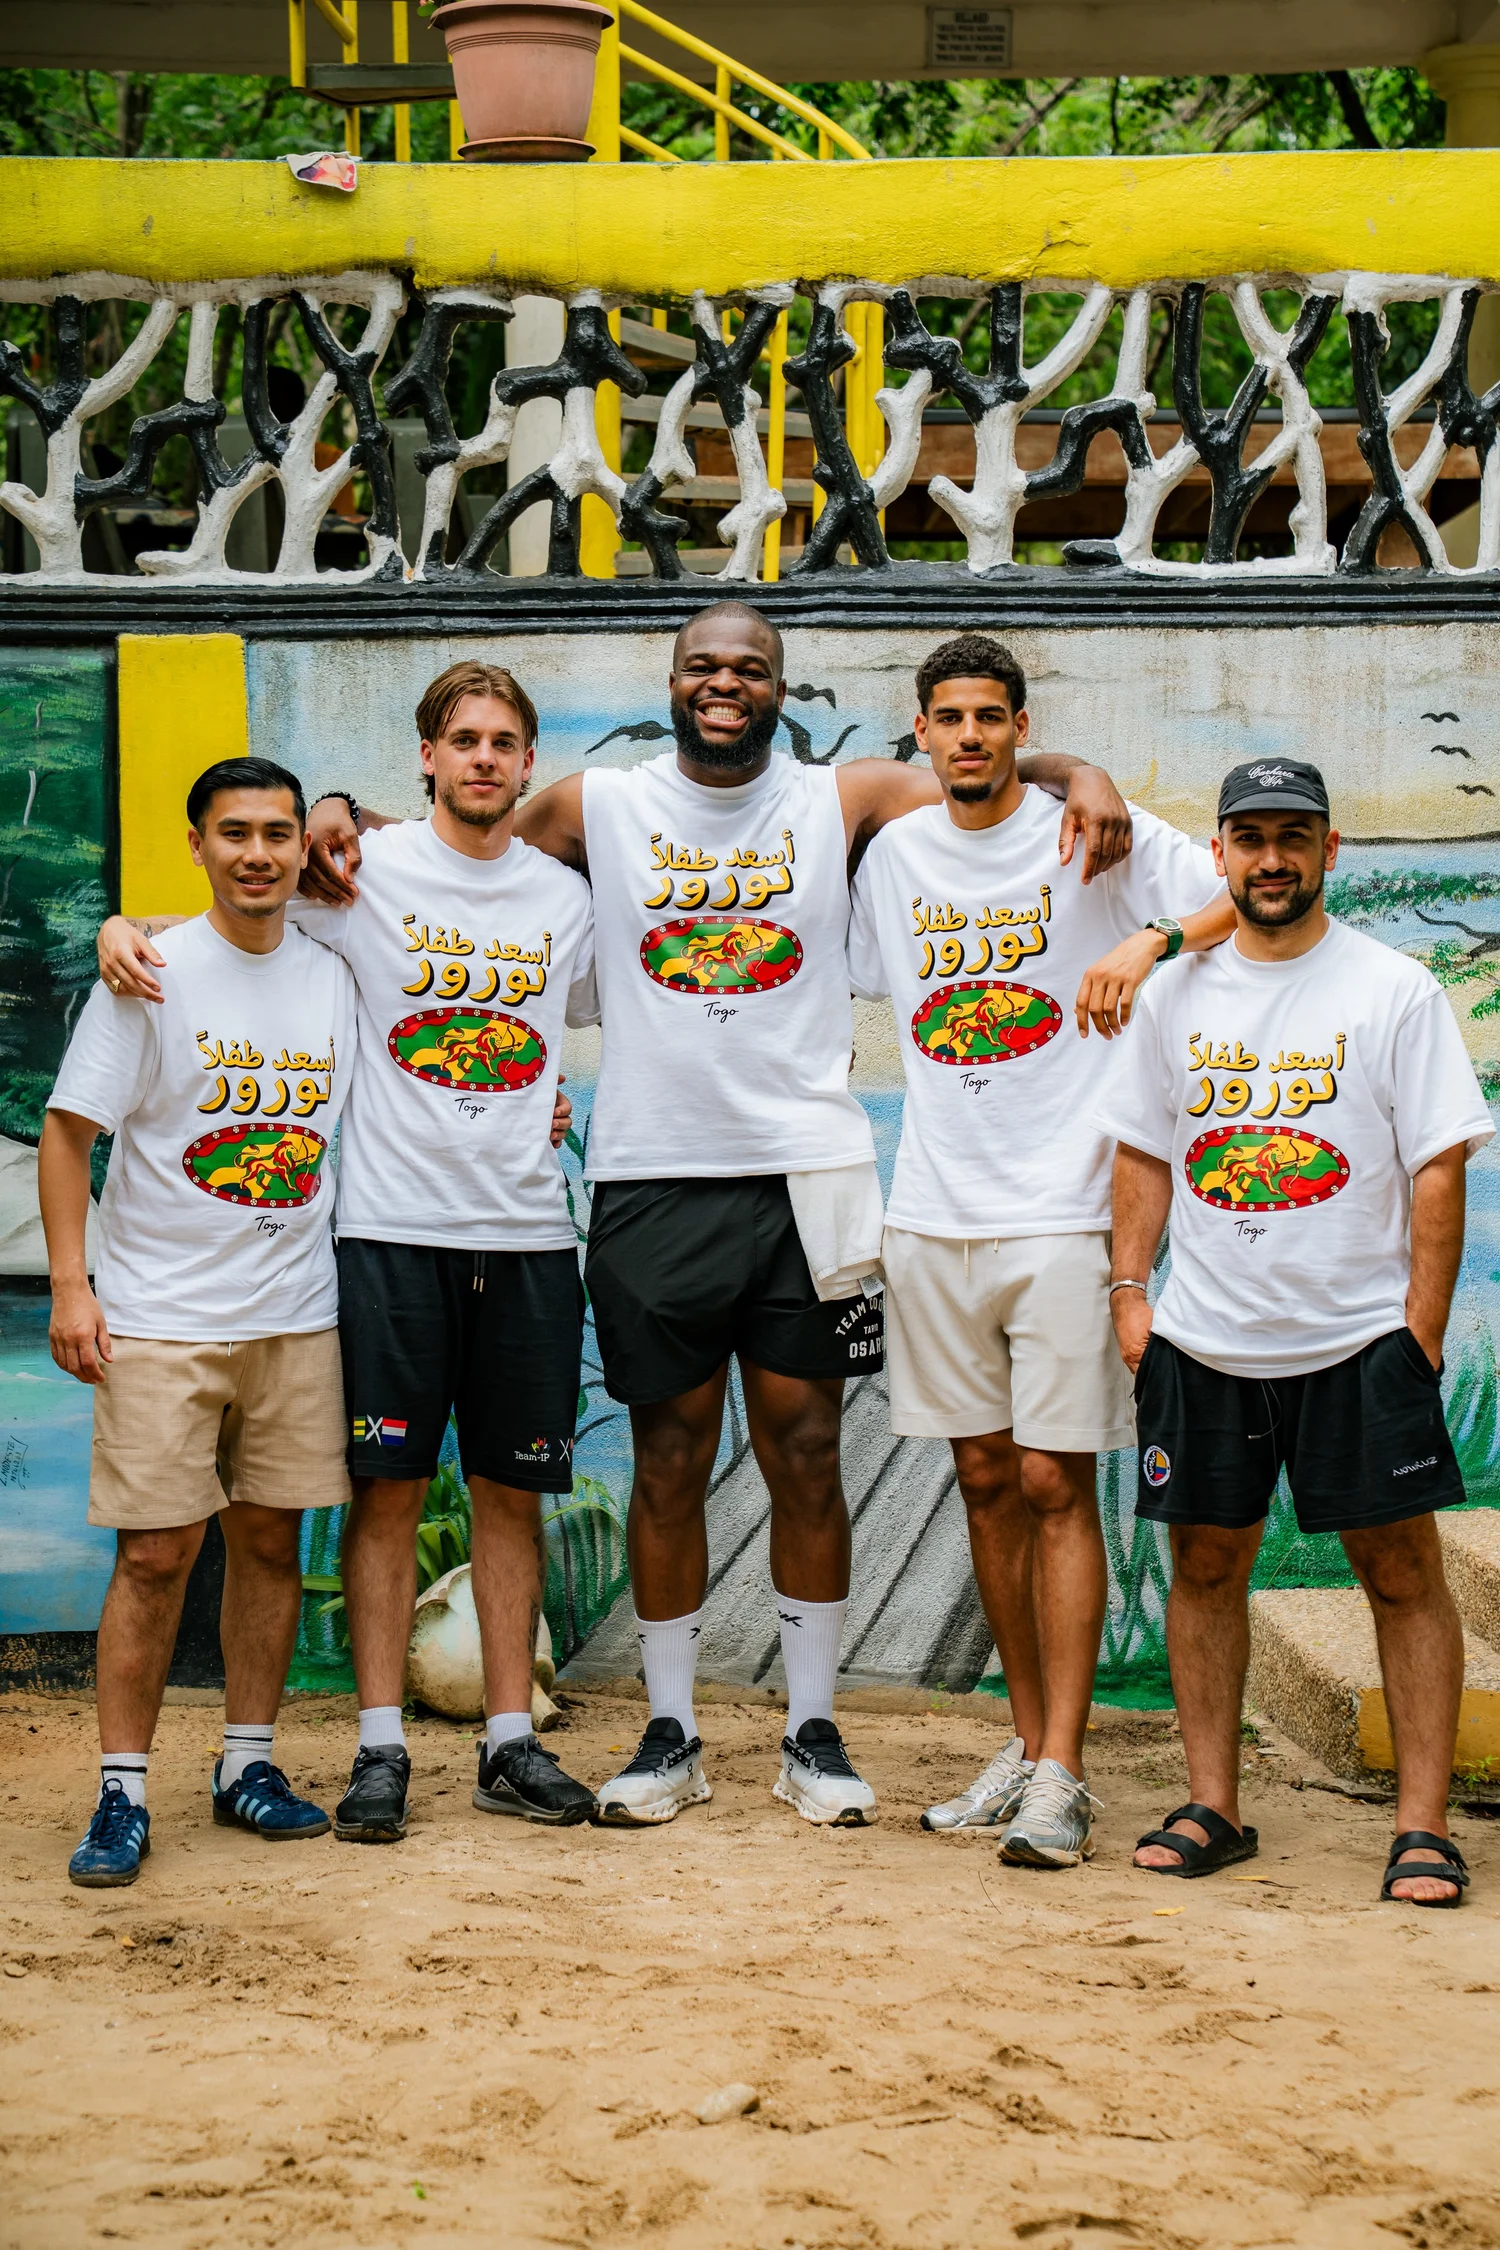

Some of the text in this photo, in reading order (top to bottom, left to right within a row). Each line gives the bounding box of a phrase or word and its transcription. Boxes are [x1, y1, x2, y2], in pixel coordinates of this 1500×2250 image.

[704, 1002, 739, 1024] Togo
[960, 1072, 992, 1095] Togo
[455, 1097, 488, 1119] Togo
[255, 1215, 287, 1237] Togo
[1234, 1219, 1268, 1243] Togo
[835, 1301, 866, 1336] TEAM
